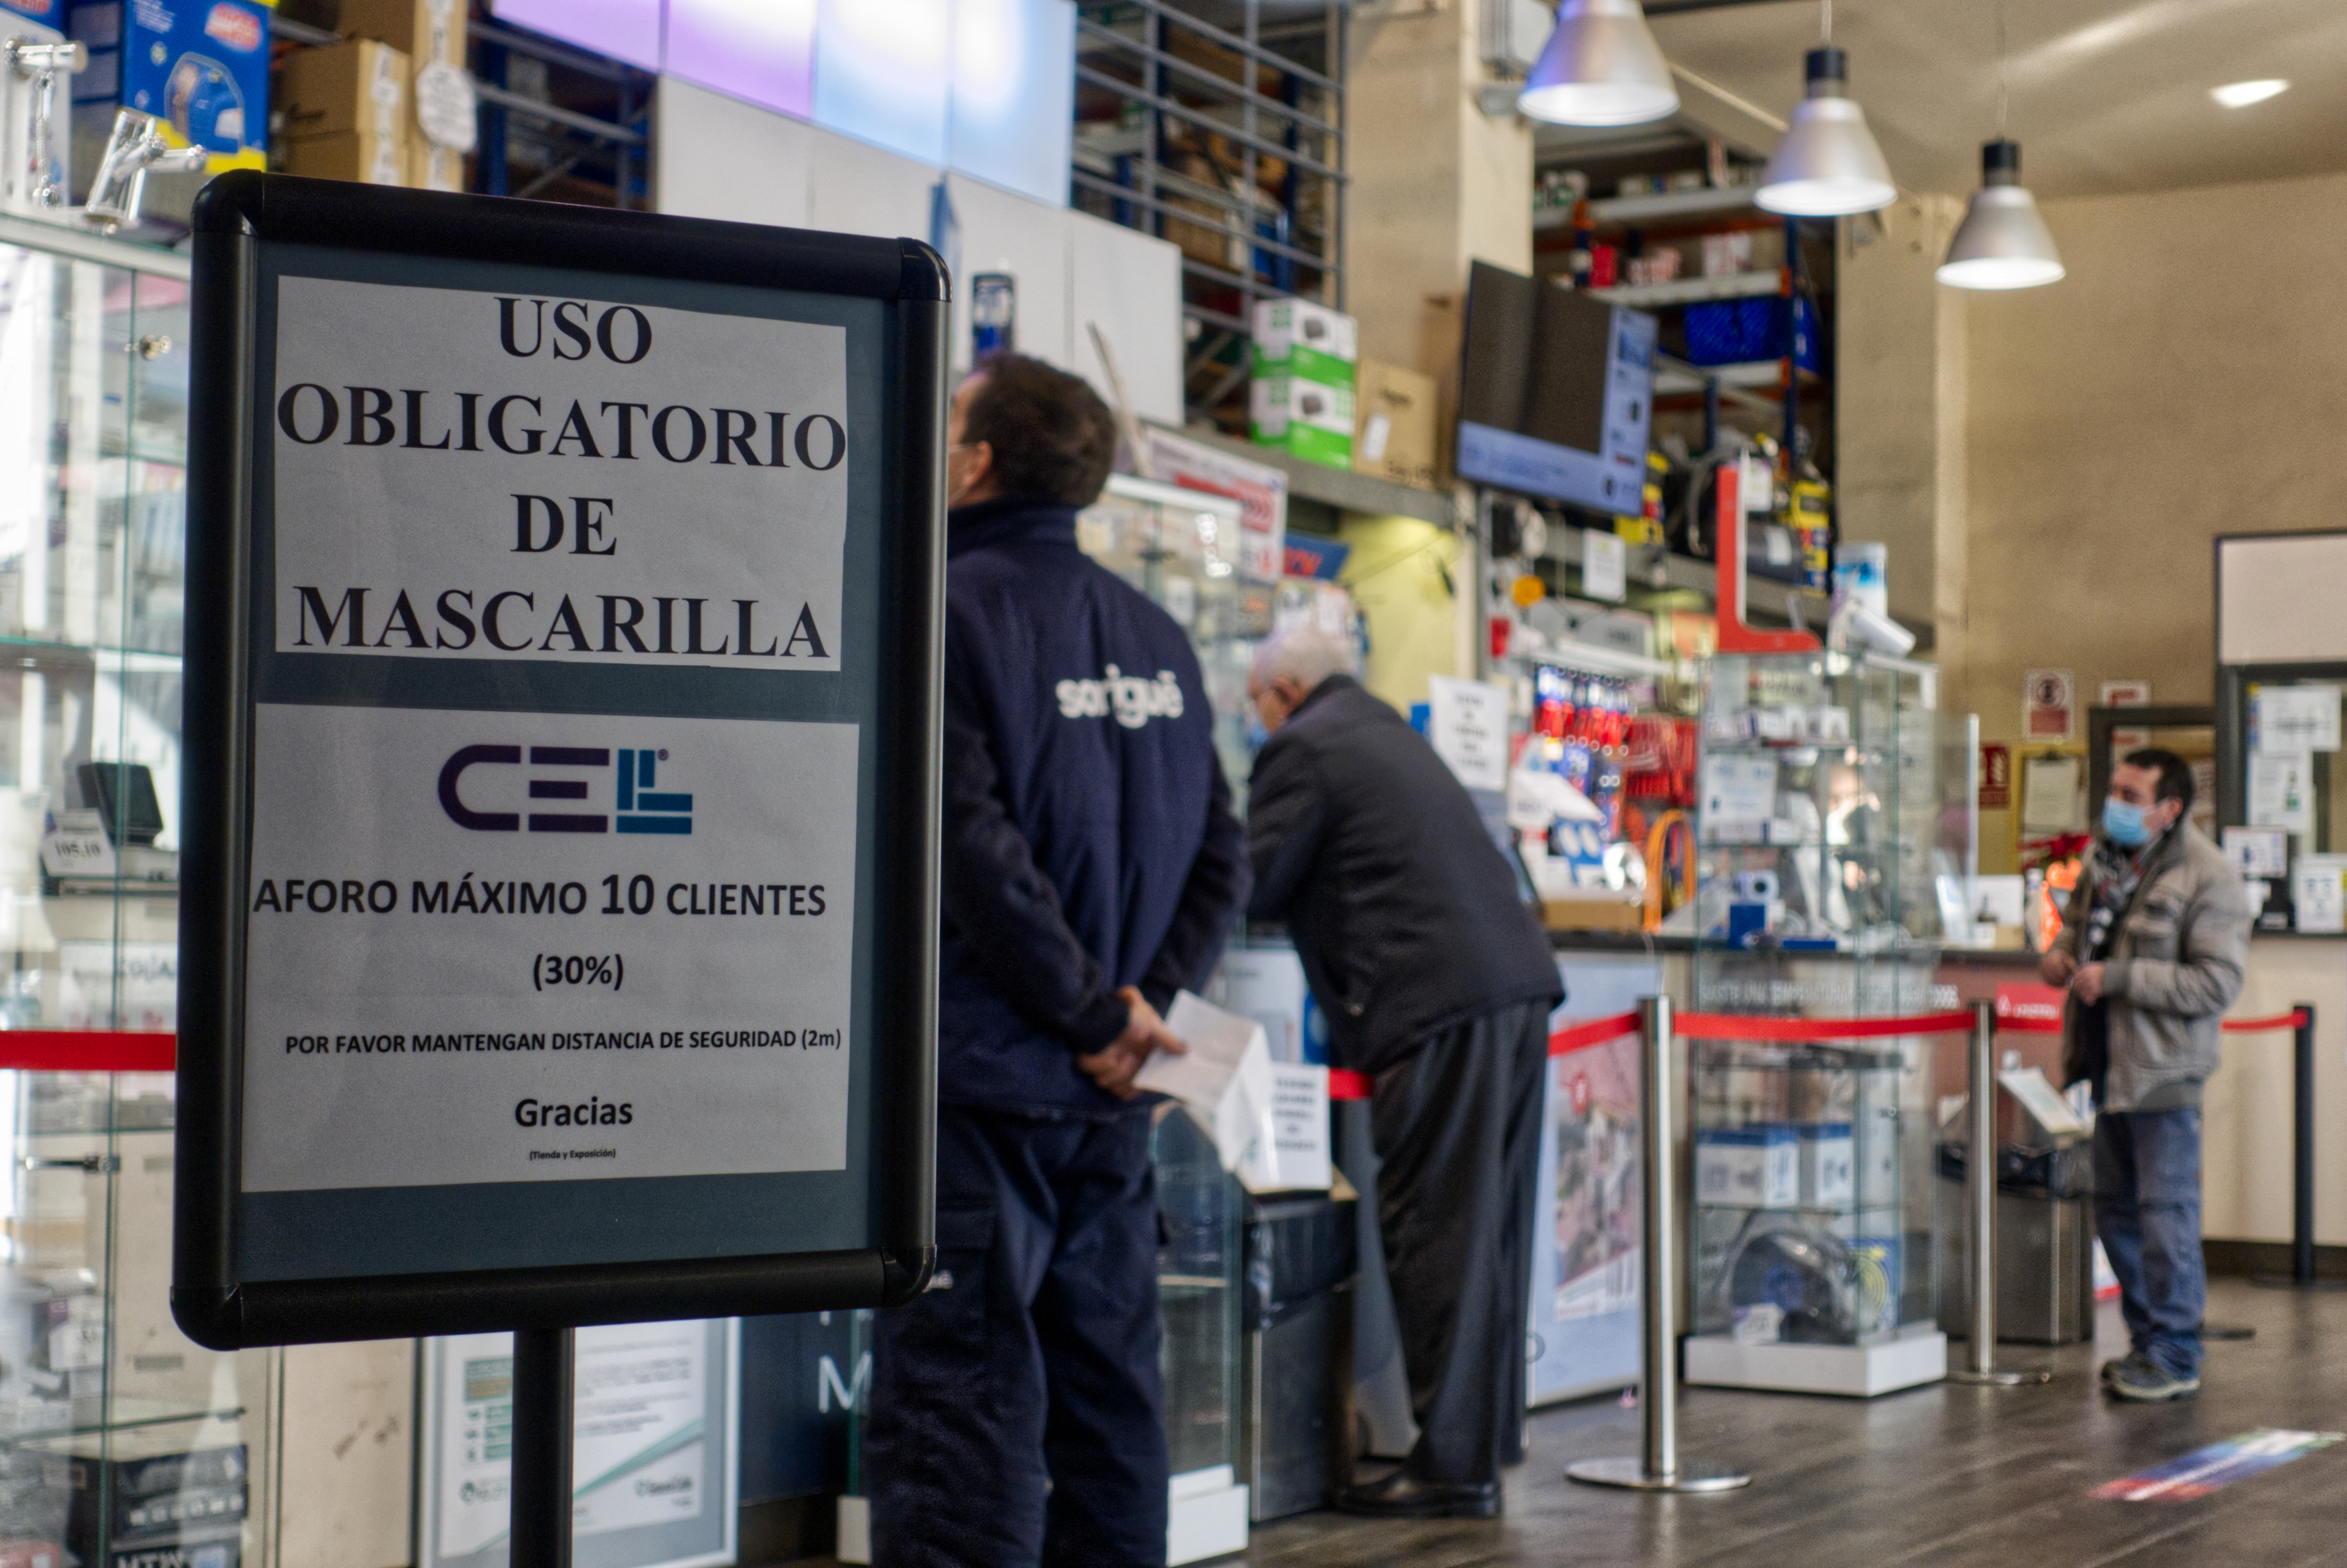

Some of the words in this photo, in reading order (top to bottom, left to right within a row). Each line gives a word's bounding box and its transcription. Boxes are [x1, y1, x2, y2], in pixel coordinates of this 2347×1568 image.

[494, 296, 653, 364] USO
[277, 383, 847, 471] OBLIGATORIO
[510, 493, 617, 556] DE
[293, 586, 831, 659] MASCARILLA
[252, 878, 398, 914] AFORO
[411, 872, 587, 915] MÁXIMO
[601, 874, 655, 916] 10
[666, 883, 826, 916] CLIENTES
[533, 954, 624, 992] (30%)
[286, 1036, 329, 1055] POR
[336, 1034, 406, 1053] FAVOR
[412, 1033, 545, 1053] MANTENGAN
[551, 1031, 654, 1051] DISTANCIA
[660, 1031, 684, 1049] DE
[689, 1030, 796, 1049] SEGURIDAD
[801, 1029, 842, 1050] (2m)
[514, 1096, 633, 1128] Gracias
[529, 1151, 561, 1161] (Tienda
[562, 1152, 568, 1160] y
[570, 1148, 616, 1159] Exposición)
